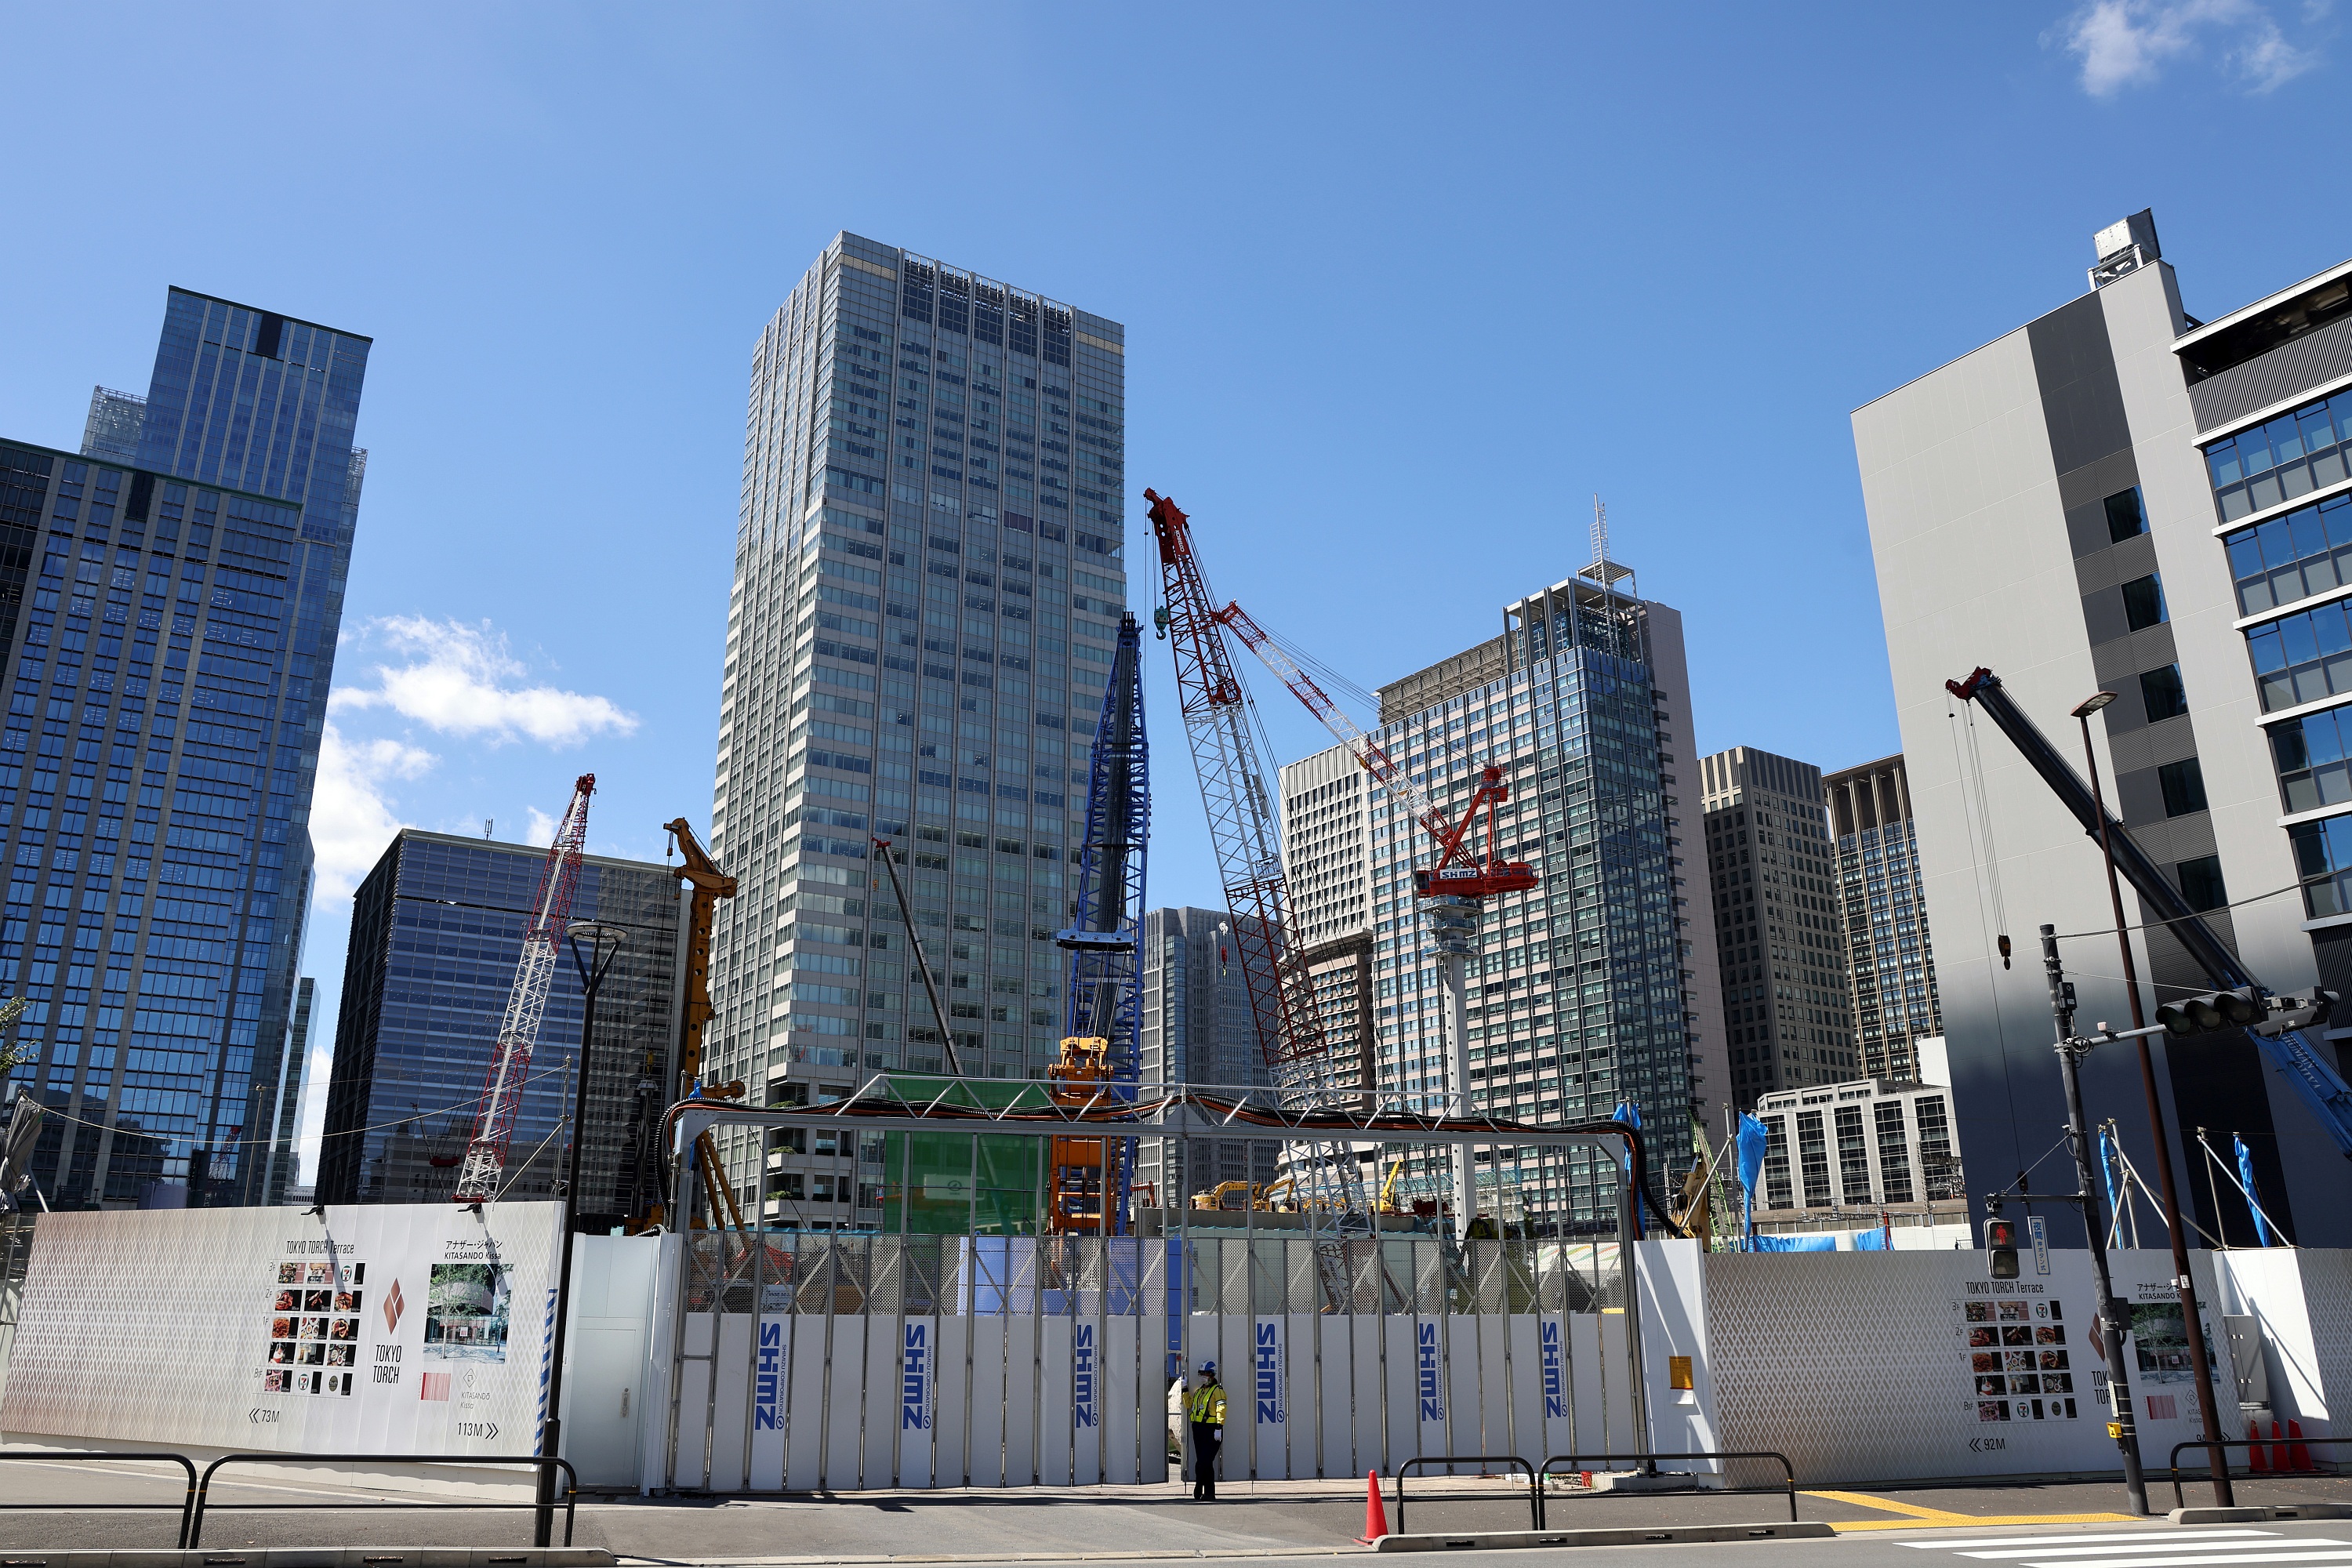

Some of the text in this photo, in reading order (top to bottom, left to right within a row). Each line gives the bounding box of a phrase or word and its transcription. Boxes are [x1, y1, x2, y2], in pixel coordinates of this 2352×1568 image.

[1175, 530, 1185, 552] KOBELCO
[286, 1240, 354, 1254] TOKYO TORCH Terrace
[269, 1262, 276, 1272] 3F
[265, 1289, 272, 1298] 2F
[1966, 1281, 2043, 1294] TOKYO TORCH Terrace
[2137, 1283, 2172, 1292] アナザー・ジ
[1952, 1302, 1960, 1311] 3F
[263, 1316, 268, 1326] 1F
[1955, 1327, 1963, 1336] 2F
[376, 1345, 402, 1363] TOKYO
[1958, 1352, 1966, 1361] 1F
[373, 1366, 400, 1384] TORCH
[2092, 1370, 2108, 1386] TOK
[2094, 1389, 2111, 1405] TOR
[1964, 1402, 1974, 1410] B1F
[262, 1410, 279, 1423] 73M
[458, 1422, 483, 1436] 113M
[1984, 1438, 2005, 1450] 92M
